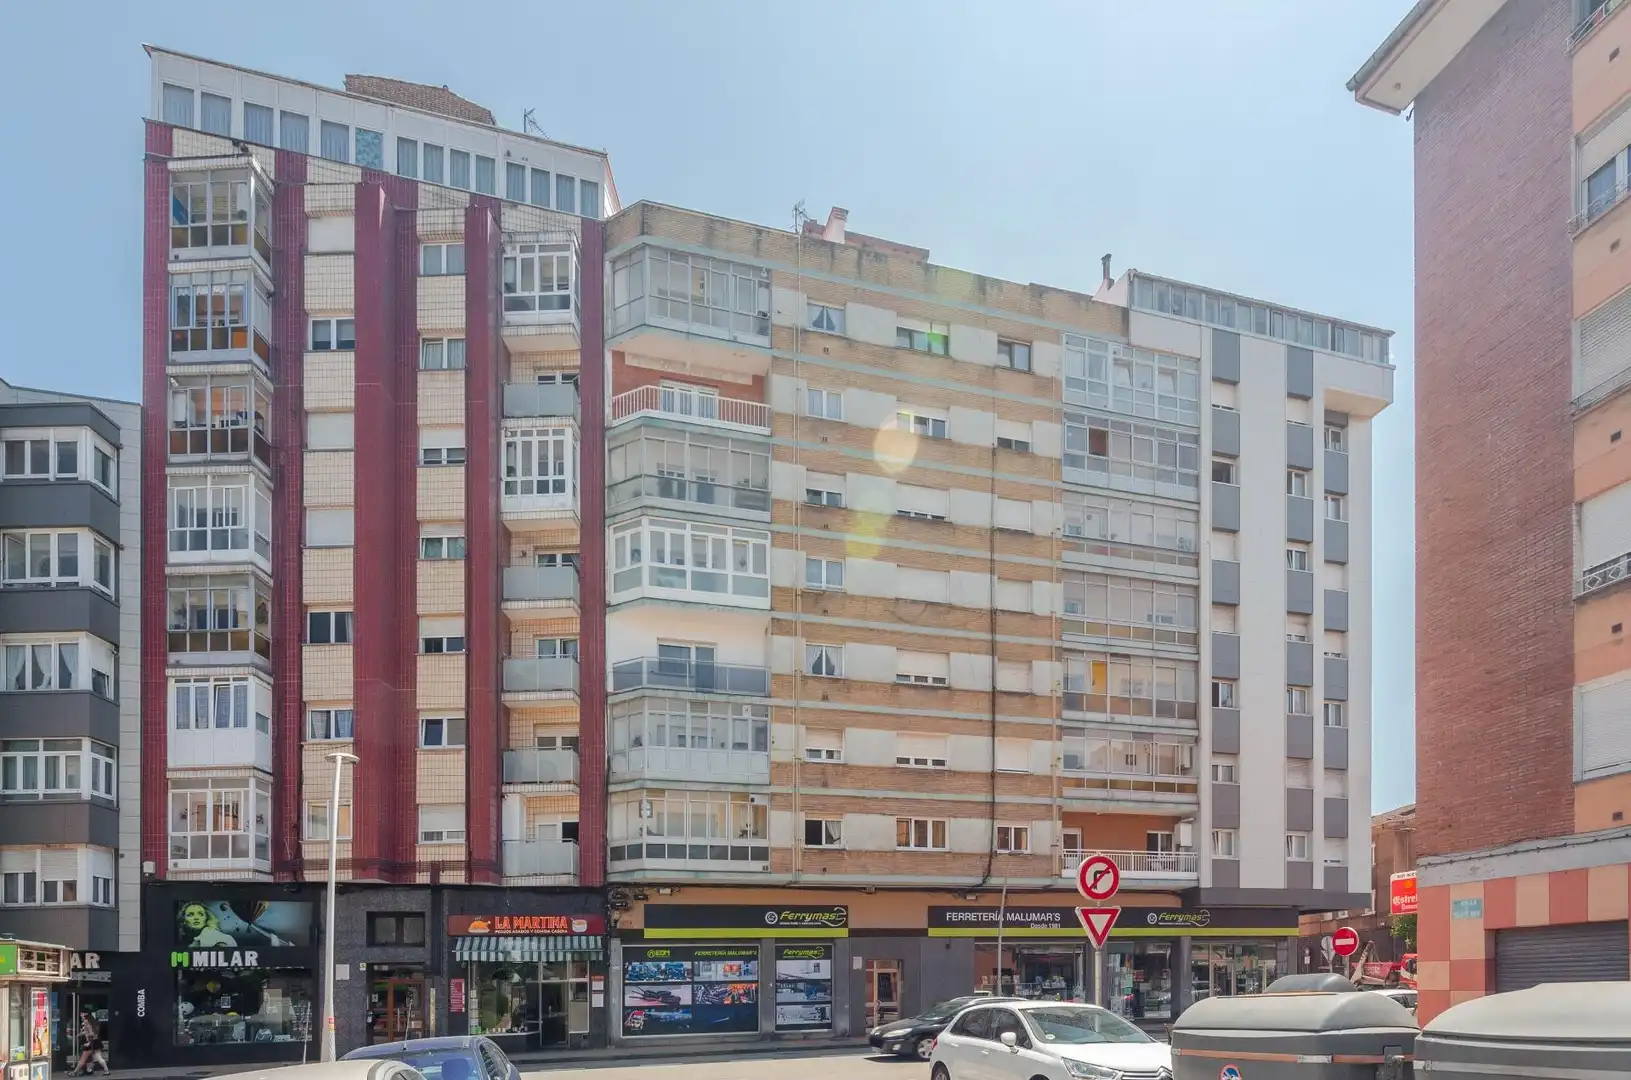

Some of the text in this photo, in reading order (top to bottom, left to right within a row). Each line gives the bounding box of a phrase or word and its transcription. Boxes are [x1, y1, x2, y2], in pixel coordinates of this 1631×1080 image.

[494, 916, 568, 929] LA MARTINA
[946, 910, 1004, 921] FERRETERÍA
[192, 950, 259, 967] MILAR
[137, 988, 146, 1018] COMBA
